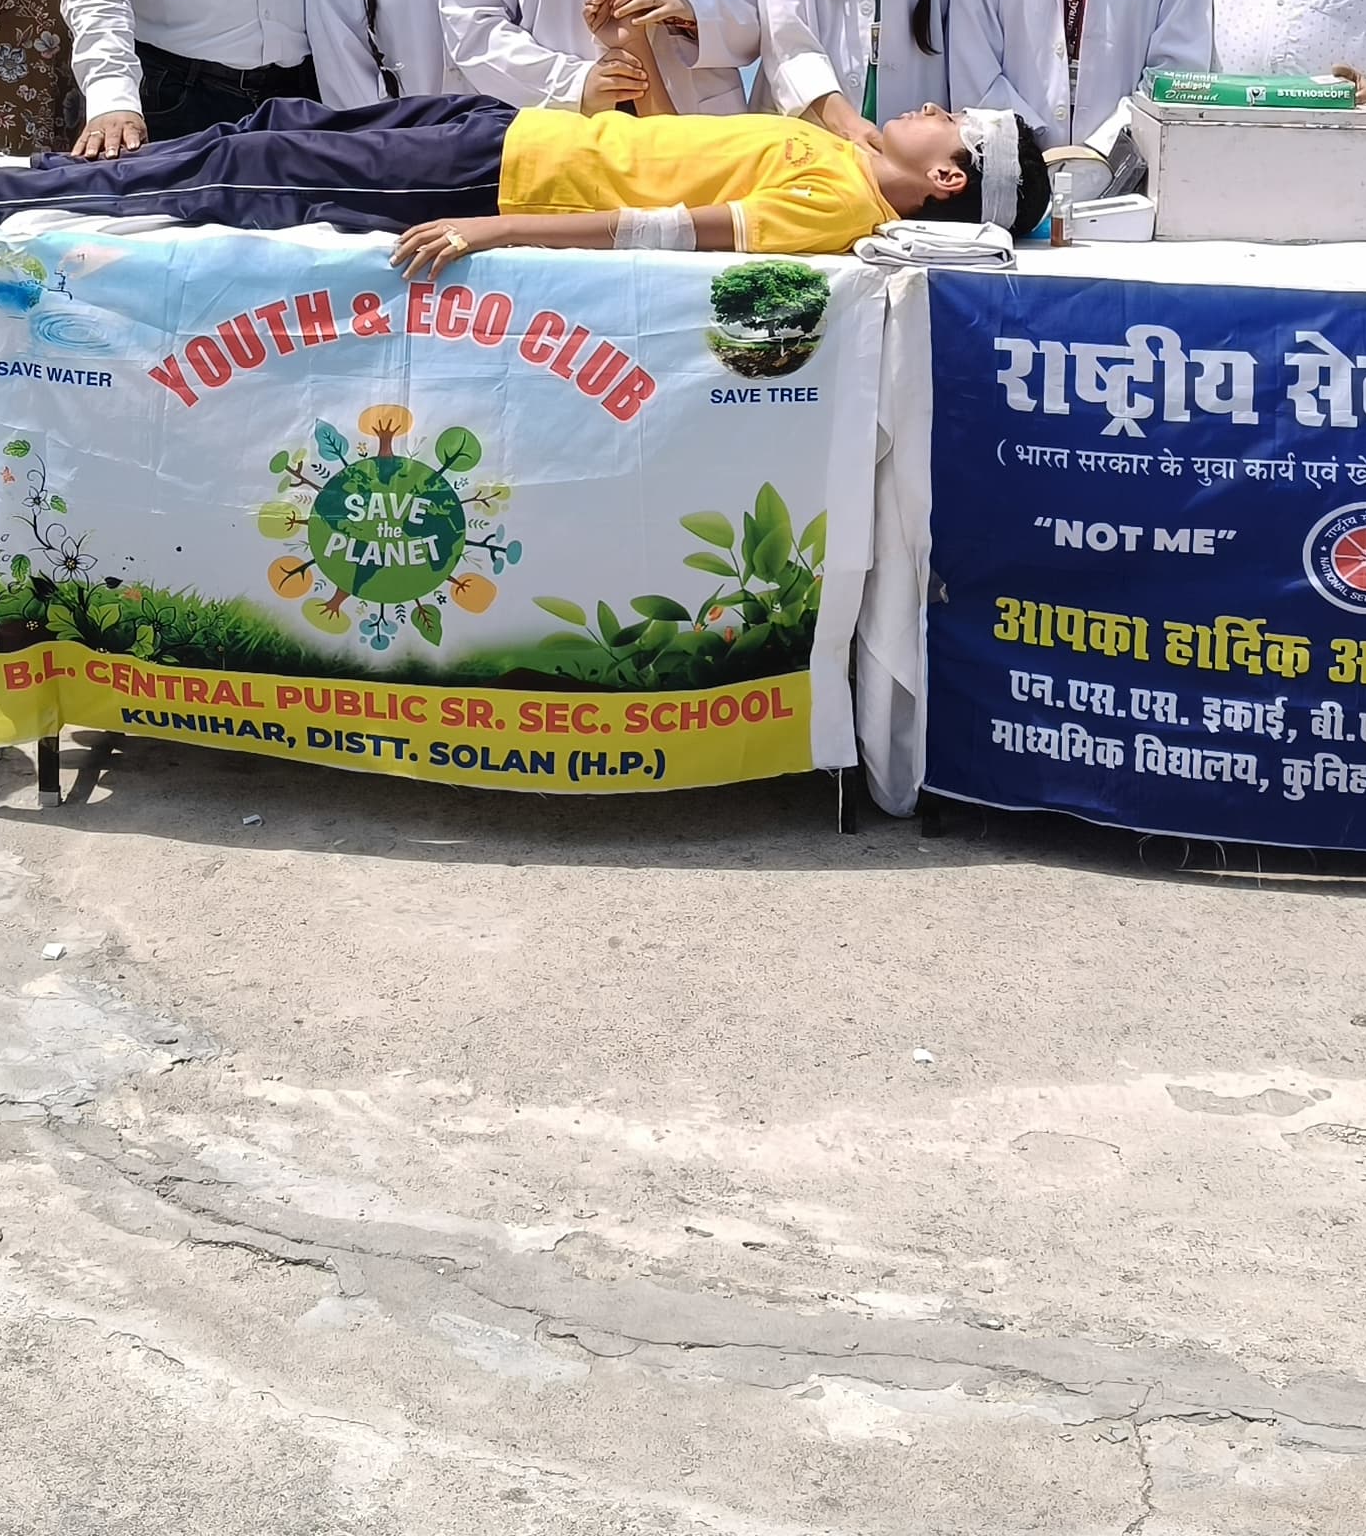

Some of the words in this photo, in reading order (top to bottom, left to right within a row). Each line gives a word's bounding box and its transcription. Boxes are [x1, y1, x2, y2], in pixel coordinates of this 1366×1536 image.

[1276, 87, 1352, 100] STETHOSCOPE
[147, 289, 338, 409] YOUTH
[352, 292, 392, 337] &
[405, 282, 513, 347] ECO
[519, 310, 657, 423] CLUB
[46, 366, 113, 387] WATER
[710, 388, 761, 404] SAVE
[767, 387, 819, 403] TREE
[993, 323, 1259, 439] राष्ट्रीय
[1015, 443, 1070, 470] भारत
[1076, 449, 1153, 476] सरकार
[1157, 447, 1184, 477] के
[1191, 455, 1237, 487] युवा
[1242, 452, 1297, 482] कार्य
[1302, 455, 1340, 490] एवं
[344, 492, 432, 525] SAVE
[376, 521, 403, 538] the
[323, 532, 441, 568] PLANET
[1319, 556, 1348, 596] NATIONAL
[993, 596, 1150, 662] आपका
[1163, 614, 1313, 679] हार्दिक
[3, 650, 78, 692] B.L.
[84, 660, 265, 710] CENTRAL
[275, 685, 429, 725] PUBLIC
[439, 697, 507, 732] SR.
[518, 701, 613, 736] SEC.
[624, 687, 795, 735] SCHOOL
[1201, 696, 1298, 744] इकाई,
[121, 707, 297, 750] KUNIHAR,
[306, 726, 419, 763] DISTT.
[428, 740, 556, 776] SOLAN
[567, 748, 666, 782] (H.P.)
[990, 717, 1125, 770] माध्यमिक
[1133, 732, 1270, 794] विद्यालय,
